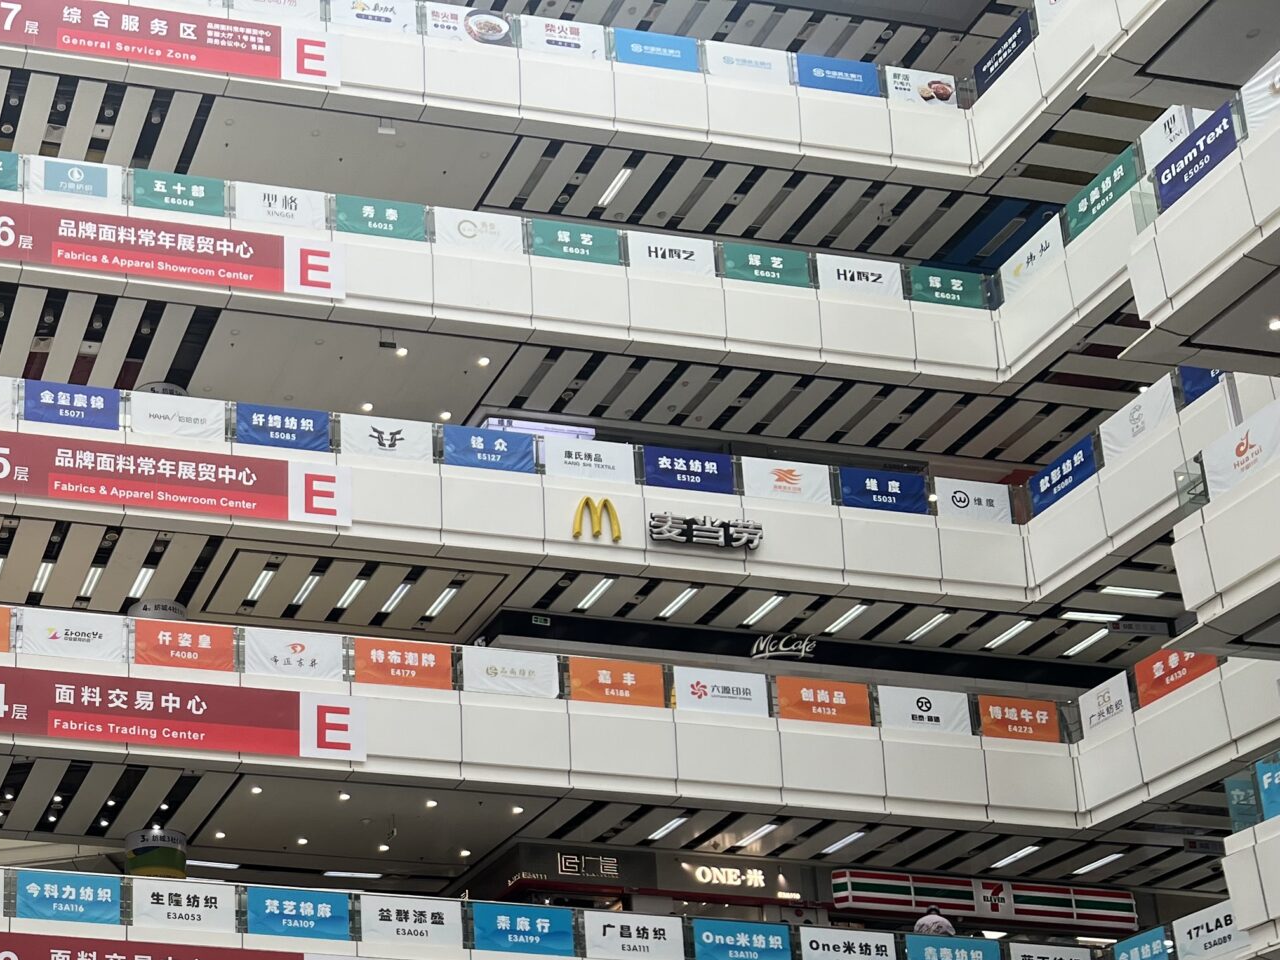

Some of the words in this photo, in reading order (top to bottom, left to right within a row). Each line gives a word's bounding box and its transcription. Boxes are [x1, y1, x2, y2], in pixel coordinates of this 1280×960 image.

[62, 6, 198, 41] 综合服务区
[62, 35, 110, 50] General
[115, 41, 162, 57] Service
[167, 50, 197, 61] Zone
[296, 39, 326, 77] E
[1160, 116, 1230, 186] GlamText
[1183, 155, 1211, 183] E5050
[153, 180, 205, 199] 五十部
[362, 205, 398, 222] 秀泰
[58, 218, 254, 258] 品牌面料常年展贸中心
[57, 249, 97, 265] Fabrics
[101, 254, 109, 264] &
[111, 255, 155, 269] Apparel
[157, 259, 215, 277] Showroom
[218, 267, 254, 281] Center
[299, 248, 331, 288] E
[470, 435, 508, 453] 铭众
[55, 448, 257, 486] 品牌面料常年展贸中心
[658, 456, 718, 475] 衣达纺织
[54, 481, 96, 495] Fabrics
[99, 486, 107, 495] &
[110, 487, 154, 501] Apparel
[157, 490, 217, 507] Showroom
[220, 498, 256, 511] Center
[304, 473, 337, 516] E
[649, 511, 764, 550] 麦当劳
[370, 647, 436, 668] 特布潮牌
[55, 684, 208, 715] 面料交易中心
[800, 687, 847, 705] 创尚品
[1089, 698, 1123, 725] 广兴纺织
[53, 718, 104, 733] Fabrics
[107, 723, 158, 739] Trading
[162, 727, 206, 741] Center
[316, 704, 352, 751] E
[25, 882, 112, 903] 今科力纺织
[150, 891, 218, 910] 生隆纺织
[166, 911, 202, 922] E3A053
[281, 918, 315, 928] F3A109
[508, 933, 540, 944] E3A199
[602, 923, 667, 941] 广昌纺织
[701, 931, 783, 950] One米纺织
[621, 943, 650, 953] E3A111
[728, 949, 759, 960] E3A110
[808, 938, 889, 957] One米纺织
